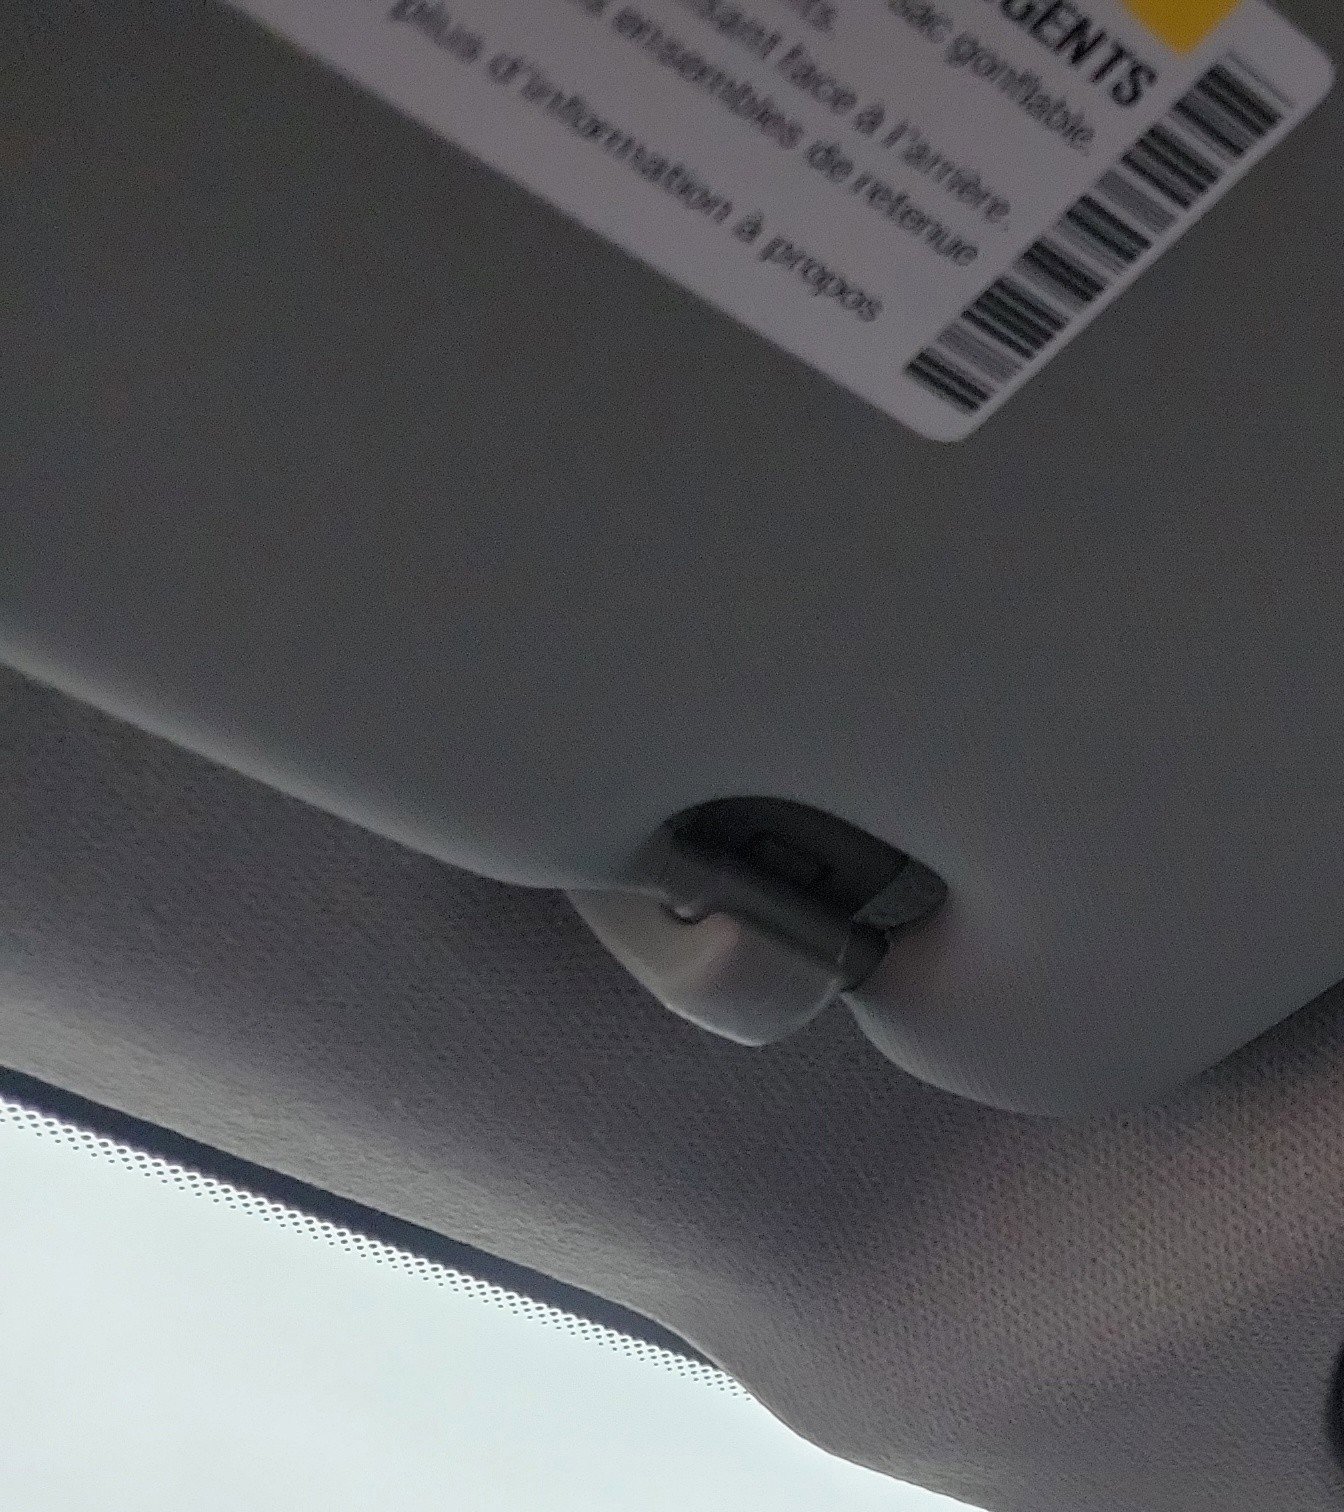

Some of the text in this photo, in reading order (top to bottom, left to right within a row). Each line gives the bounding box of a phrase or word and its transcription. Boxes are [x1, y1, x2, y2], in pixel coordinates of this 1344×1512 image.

[487, 53, 733, 226] d'information
[732, 210, 764, 244] à
[758, 236, 883, 323] propos
[611, 7, 979, 267] ensembles de retenue
[777, 43, 856, 115] face
[852, 103, 885, 137] à
